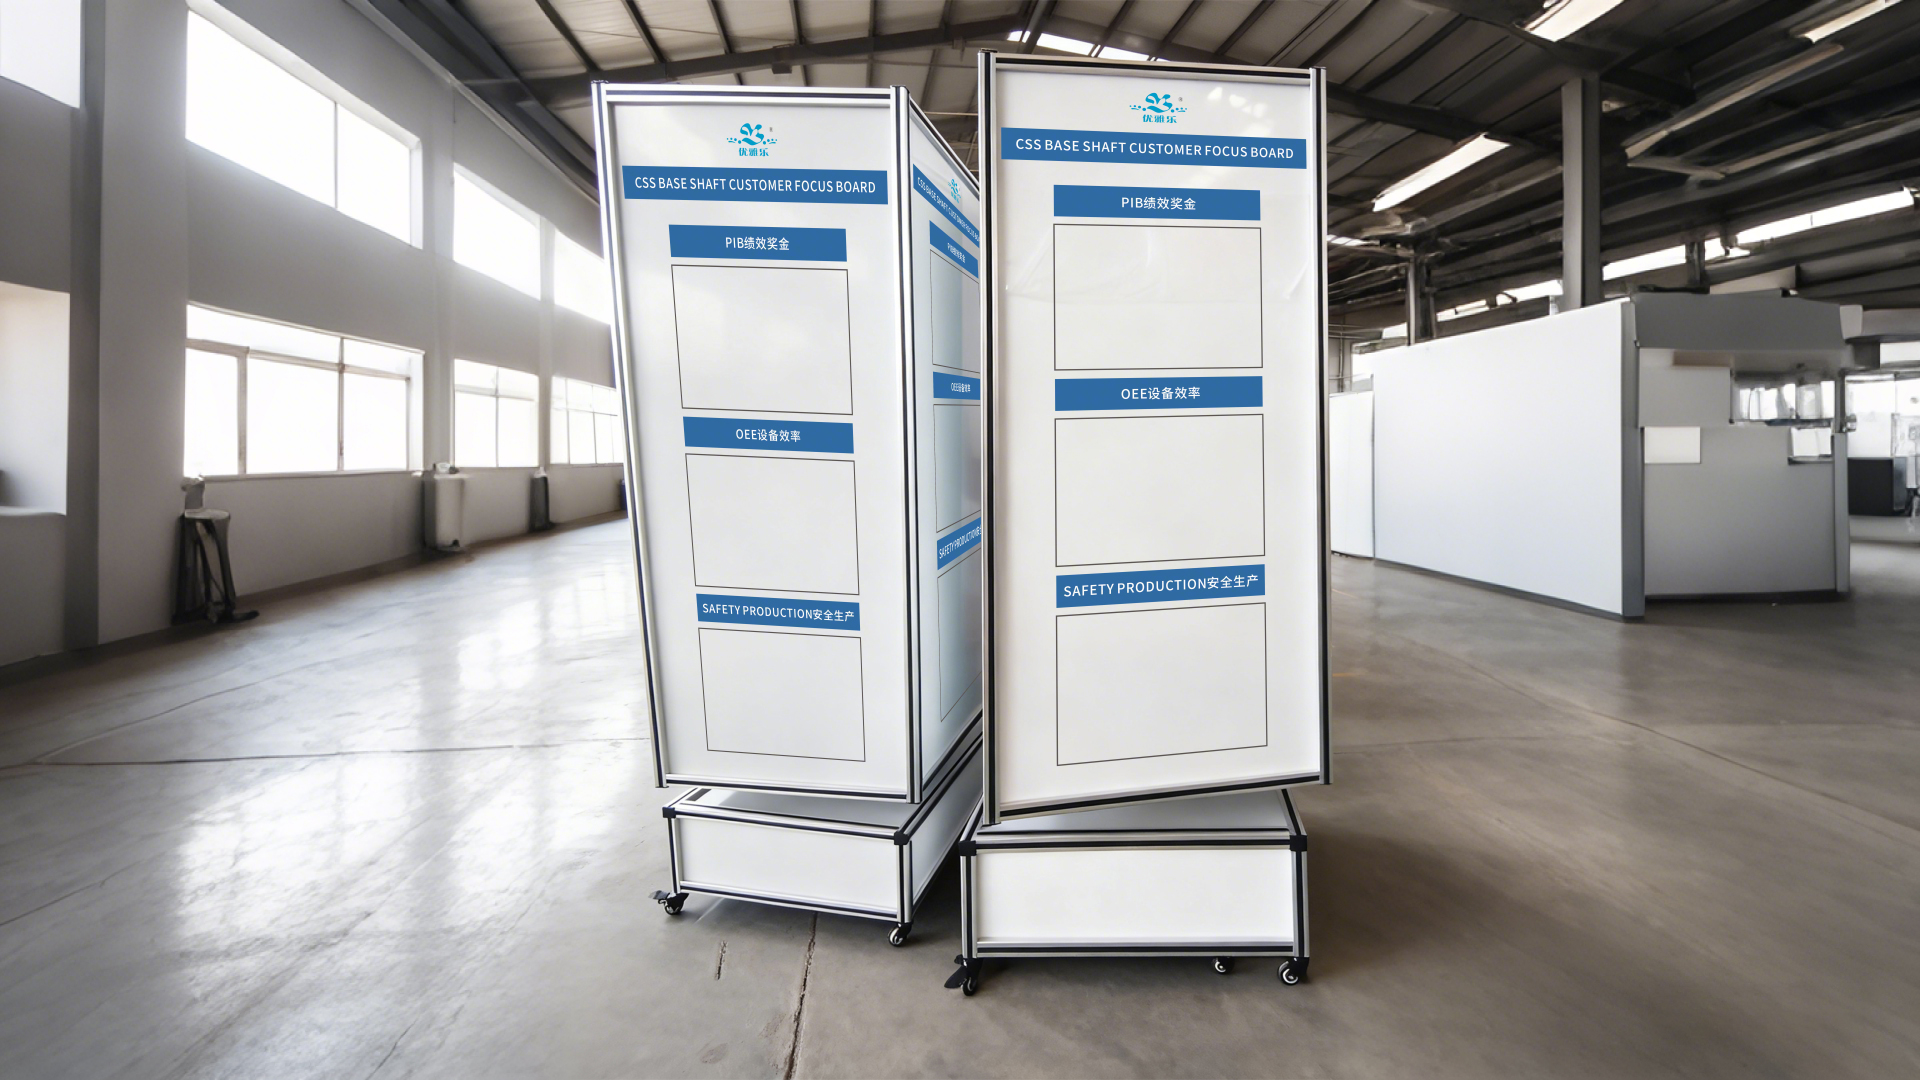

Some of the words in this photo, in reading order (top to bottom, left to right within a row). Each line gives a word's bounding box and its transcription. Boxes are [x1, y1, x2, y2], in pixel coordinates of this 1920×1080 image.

[1142, 114, 1178, 124] 优雅乐
[738, 147, 770, 157] 优雅乐
[1016, 139, 1042, 151] CSS
[1045, 140, 1080, 152] BASE
[1083, 141, 1127, 153] SHAFT
[1130, 143, 1202, 156] CUSTOMER
[1204, 146, 1248, 158] FOCUS
[1251, 147, 1294, 159] BOARD
[634, 176, 657, 189] CSS
[658, 177, 688, 190] BASE
[690, 178, 727, 191] SHAFT
[729, 179, 793, 192] CUSTOMER
[795, 180, 834, 193] FOCUS
[836, 181, 876, 194] BOARD
[1121, 196, 1197, 211] PIB绩效奖金
[725, 236, 790, 251] PIB绩效奖金
[1120, 387, 1201, 400] OEE设备效率
[735, 428, 801, 443] OEE设备效率
[1063, 584, 1115, 598] SAFETY
[1117, 574, 1259, 594] PRODUCTION安全生产
[702, 603, 741, 615] SAFETY
[743, 605, 855, 622] PRODUCTION安全生产
